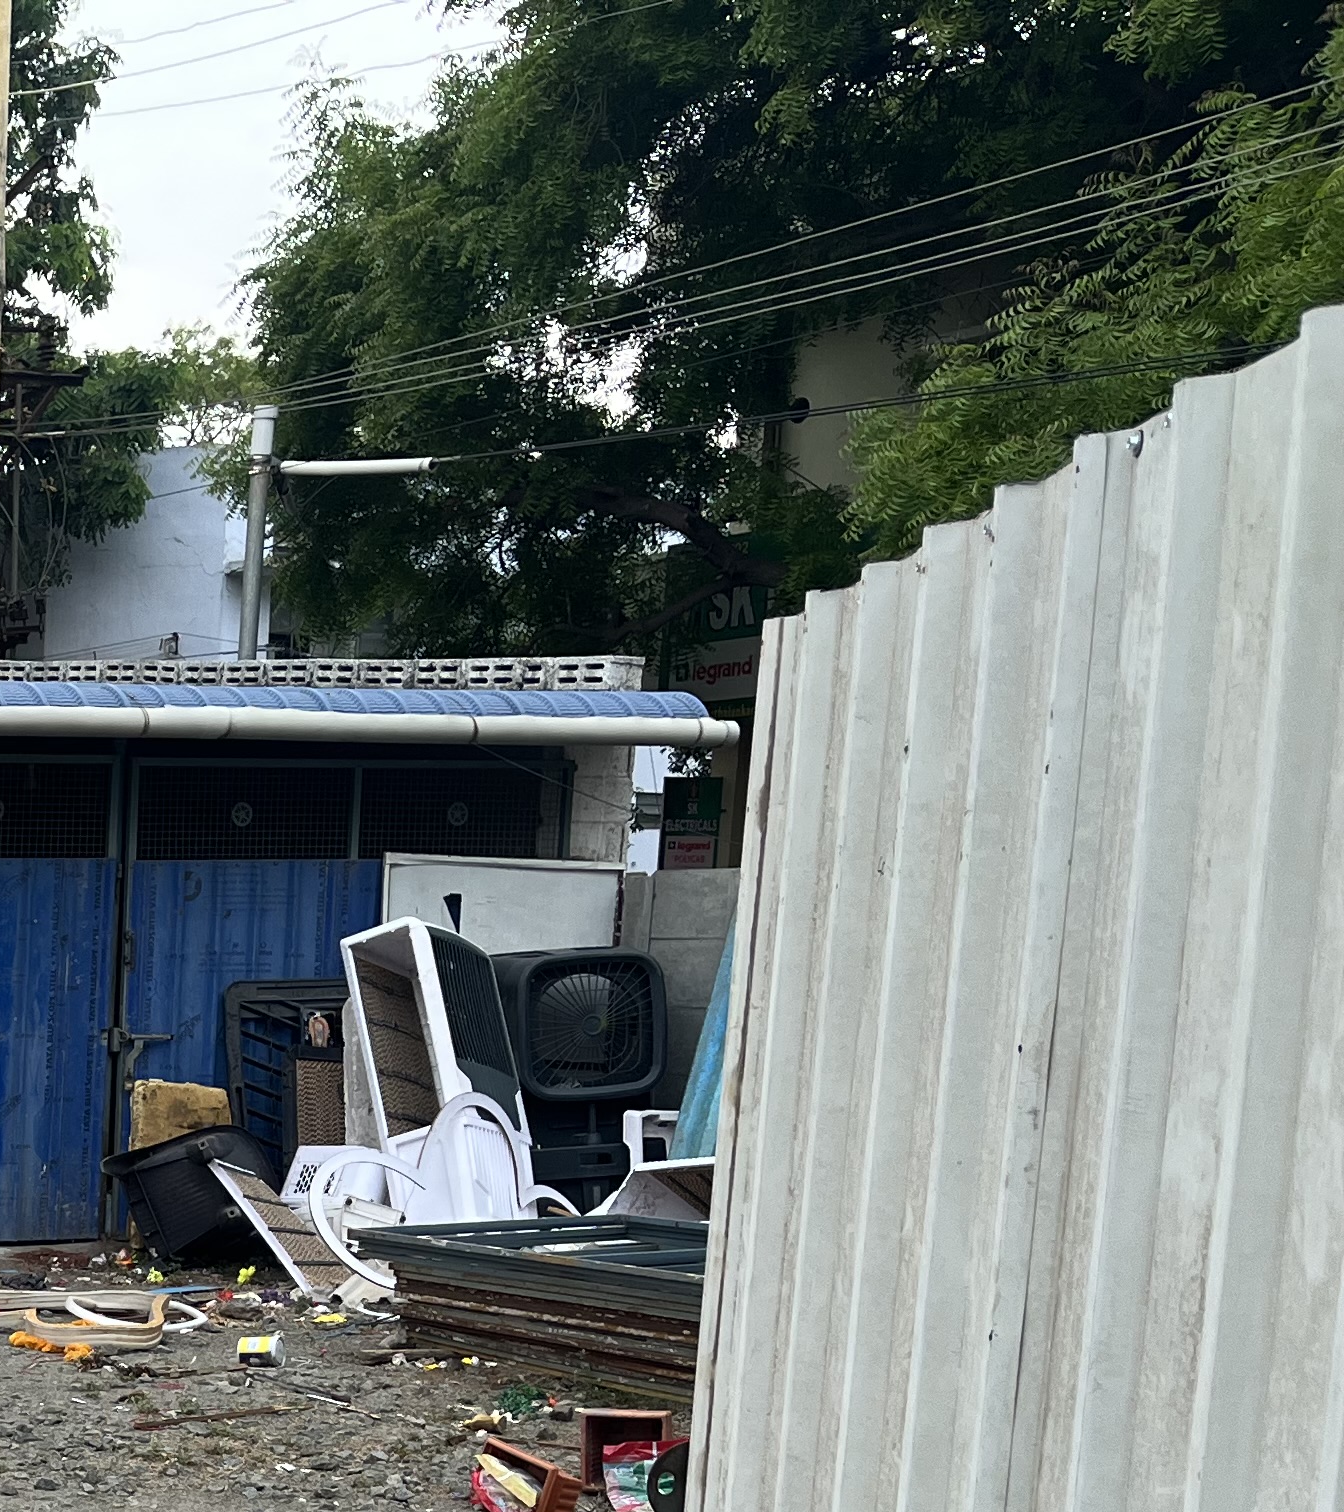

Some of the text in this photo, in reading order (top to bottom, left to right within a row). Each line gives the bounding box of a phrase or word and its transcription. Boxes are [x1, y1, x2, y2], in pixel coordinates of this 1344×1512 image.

[708, 586, 755, 631] SK
[692, 655, 753, 685] legrand
[665, 818, 718, 832] ELECTRICALS
[93, 884, 102, 910] TATA
[45, 1045, 54, 1070] TATA
